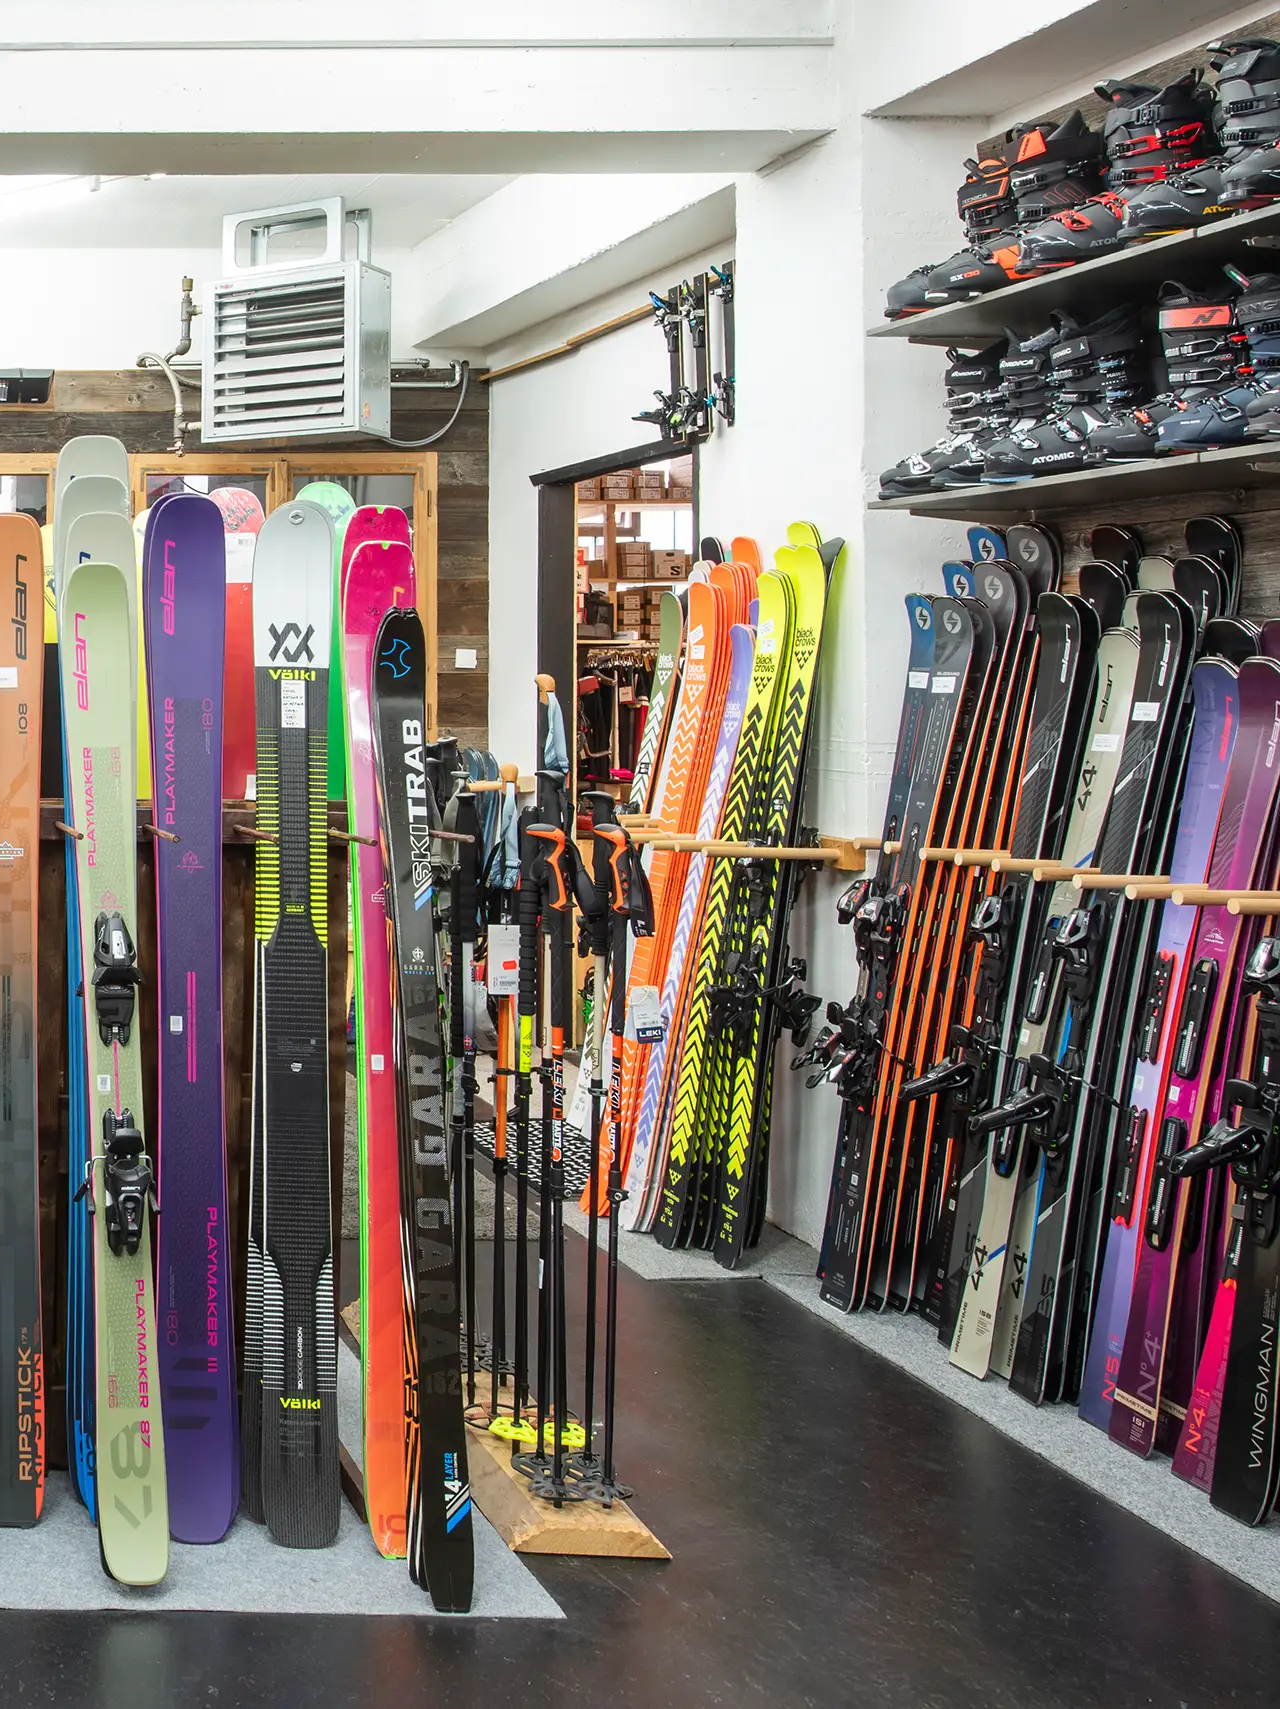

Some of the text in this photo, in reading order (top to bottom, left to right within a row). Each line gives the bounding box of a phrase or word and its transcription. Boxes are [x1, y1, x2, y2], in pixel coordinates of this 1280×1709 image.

[1090, 236, 1119, 247] ATOM
[950, 269, 980, 282] SX130
[1237, 300, 1277, 317] ANG
[951, 370, 982, 378] NORDICA
[1000, 358, 1033, 368] NORDICA
[1032, 451, 1075, 465] ATOMIC
[159, 539, 176, 636] elan
[670, 566, 680, 576] S
[11, 554, 27, 660] elan
[795, 638, 816, 647] crows
[796, 628, 813, 637] black
[74, 612, 87, 711] elan
[659, 653, 672, 661] black
[688, 664, 704, 672] black
[754, 664, 775, 673] crows
[756, 655, 772, 664] black
[1060, 624, 1070, 683] elan
[1158, 623, 1170, 687] elan
[268, 668, 315, 681] Völkl
[687, 672, 706, 681] crows
[1099, 664, 1113, 723] elan
[18, 703, 28, 735] 108
[202, 698, 213, 732] 180
[165, 696, 174, 825] PLAYMAKER
[86, 747, 96, 868] PLAYMAKER
[402, 719, 432, 888] SKITRAB
[638, 1029, 661, 1037] LEKI
[553, 1060, 563, 1108] LEKI
[207, 1206, 218, 1373] PLAYMAKER III
[166, 1309, 179, 1346] 180
[954, 1301, 968, 1353] PRIMETIME
[1007, 1314, 1019, 1368] PRIMETIME
[135, 1278, 152, 1449] PLAYMAKER 87
[108, 1374, 119, 1410] 166
[280, 1397, 320, 1410] Völkl
[1248, 1323, 1274, 1468] WINGMAN
[19, 1346, 31, 1481] RIPSTICK
[1185, 1407, 1206, 1453] N°4
[444, 1452, 454, 1480] LAYER
